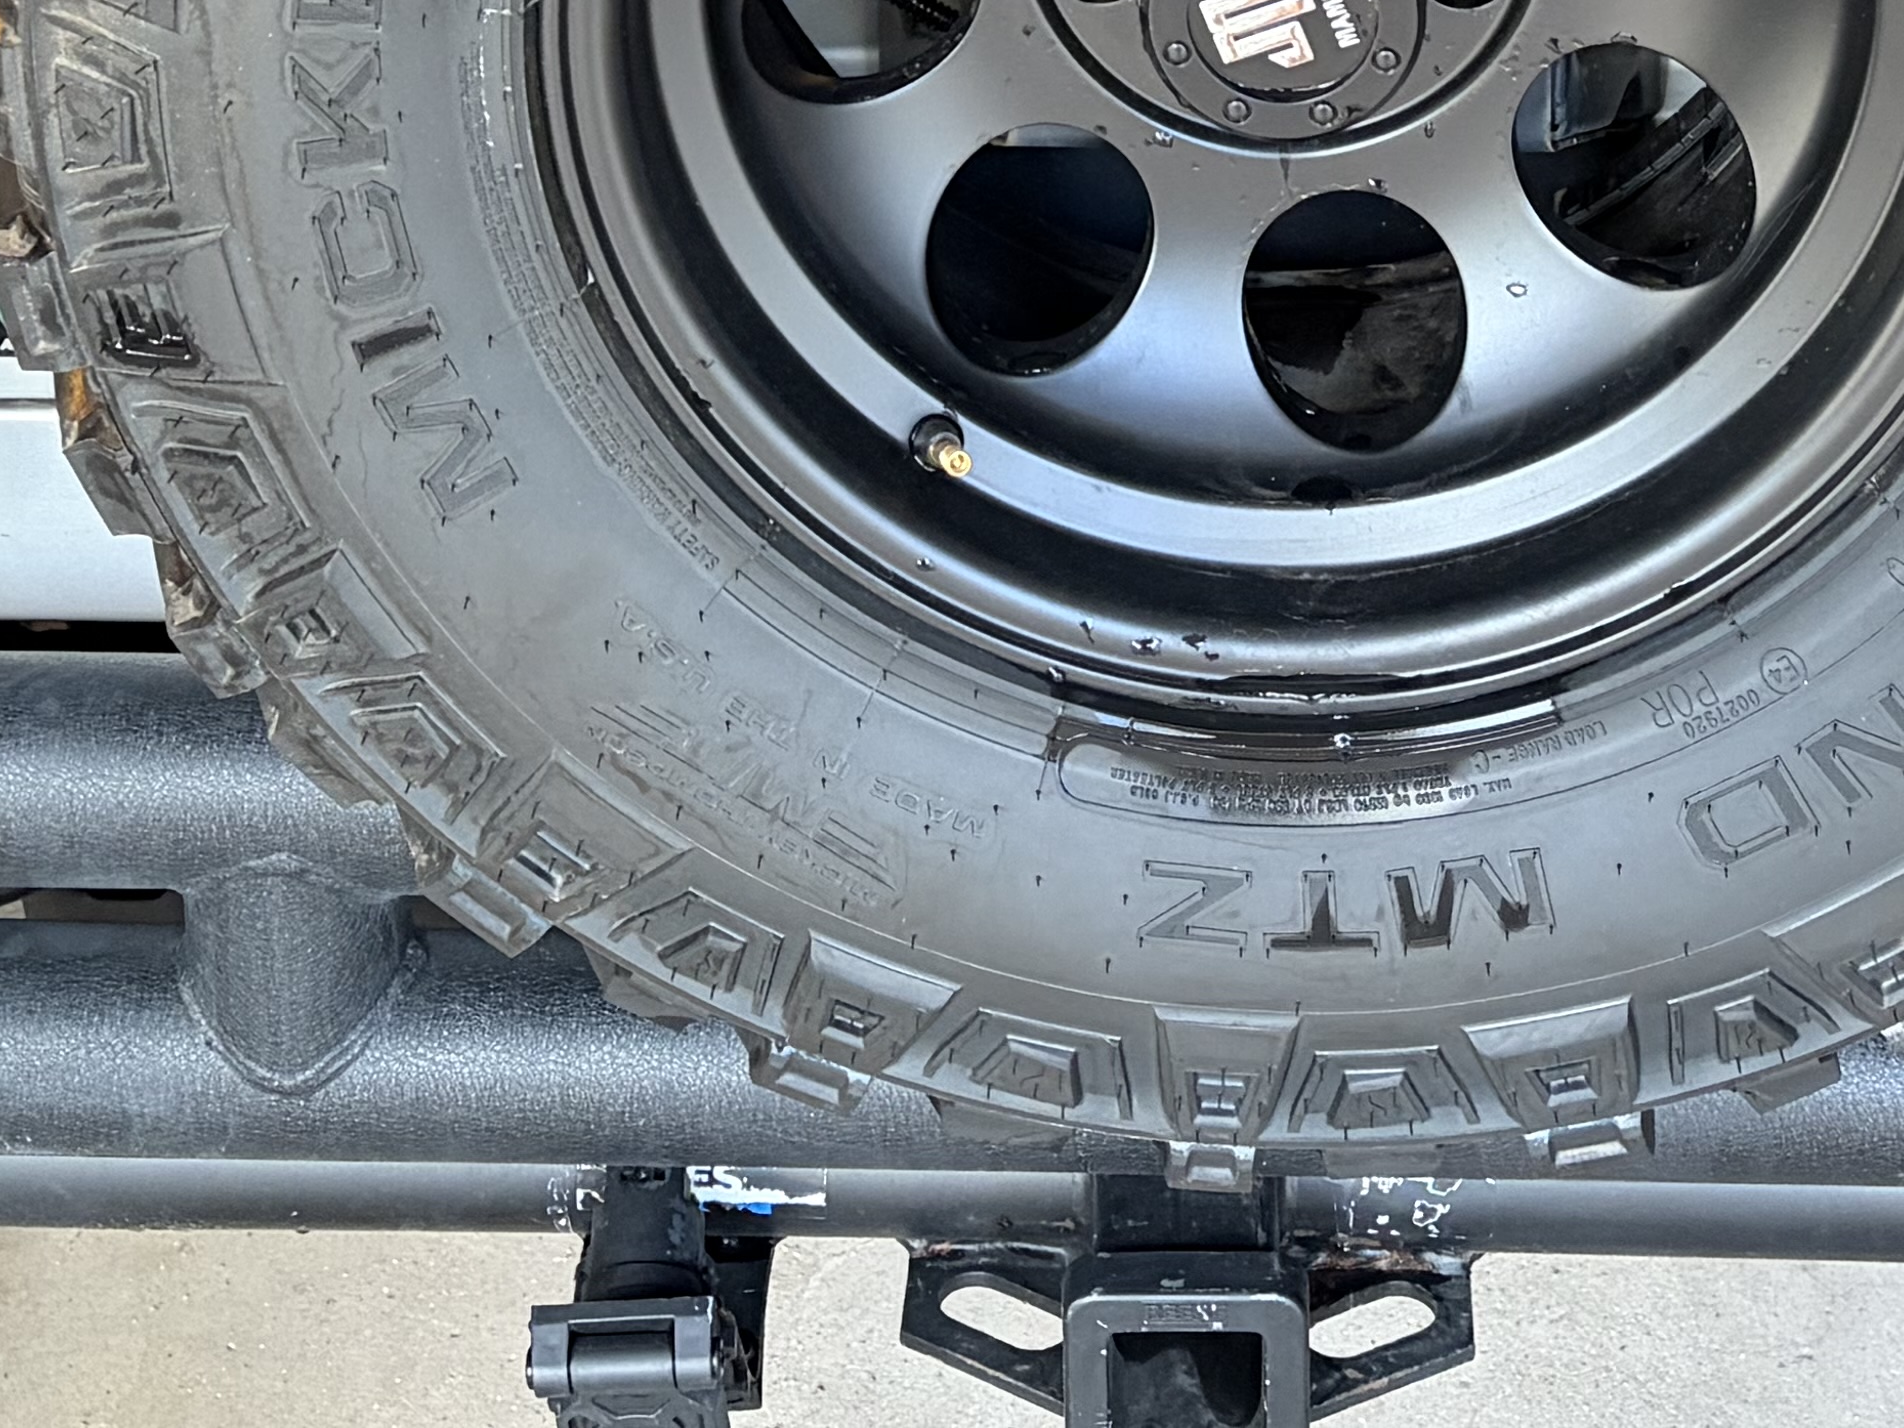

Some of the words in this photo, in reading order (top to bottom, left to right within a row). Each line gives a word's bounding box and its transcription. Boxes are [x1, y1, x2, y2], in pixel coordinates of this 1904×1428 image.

[663, 516, 723, 574] SAFETY
[719, 688, 801, 755] THE
[1638, 666, 1722, 731] POR
[806, 741, 855, 784] IN
[862, 770, 991, 844] MADE
[1129, 840, 1564, 958] MTZ
